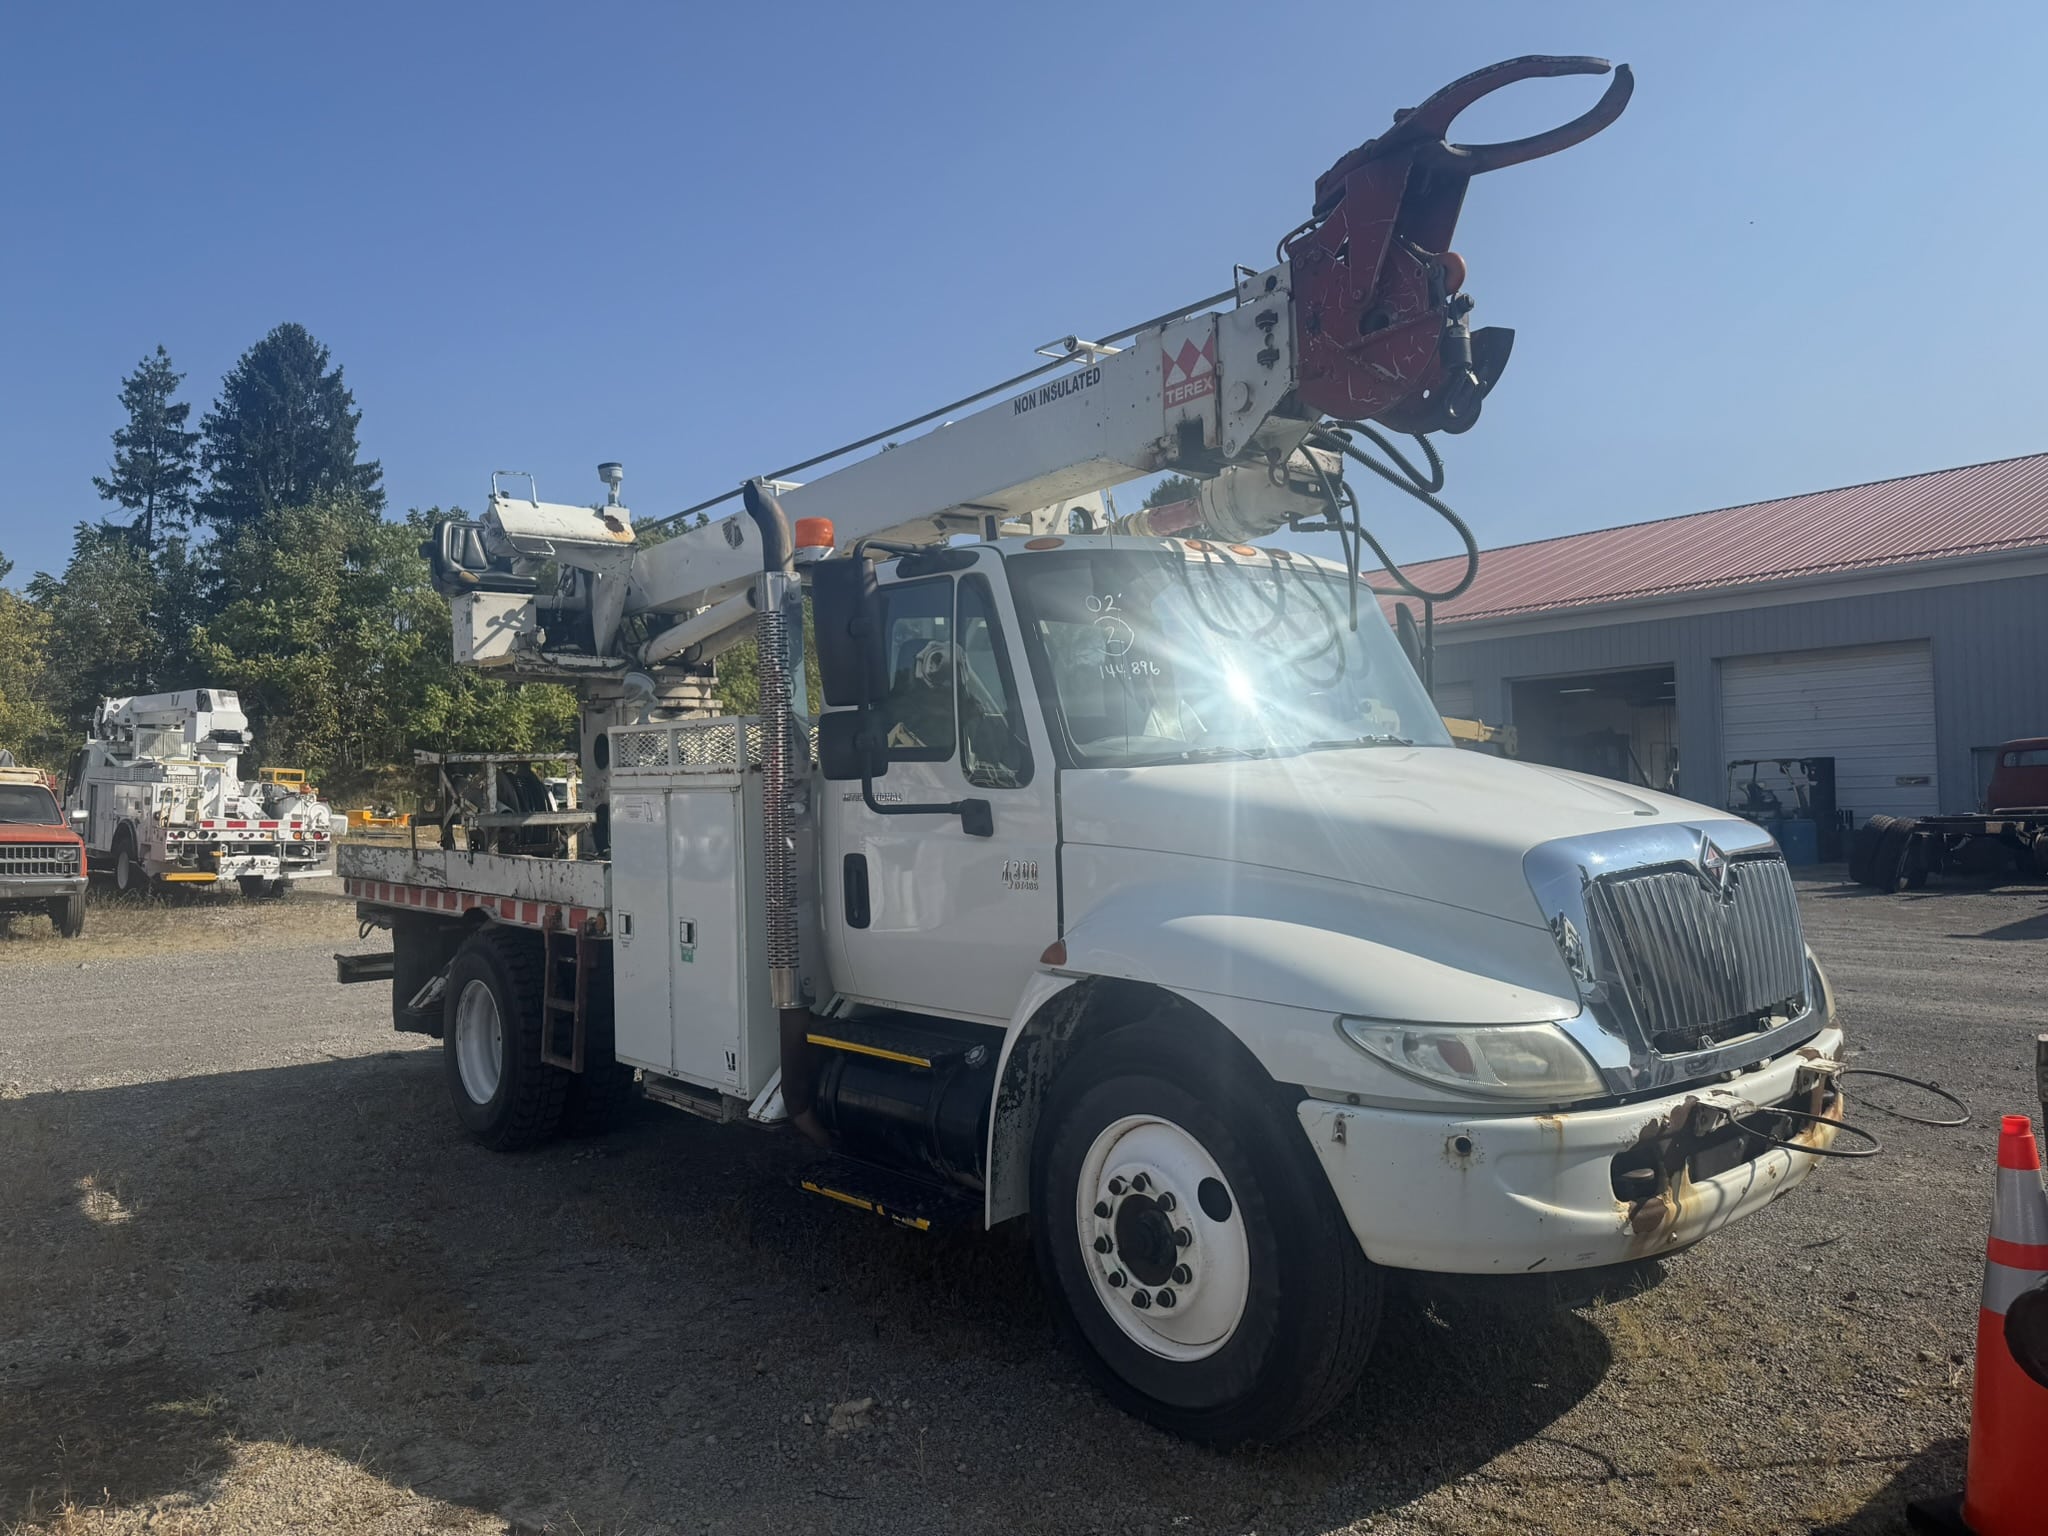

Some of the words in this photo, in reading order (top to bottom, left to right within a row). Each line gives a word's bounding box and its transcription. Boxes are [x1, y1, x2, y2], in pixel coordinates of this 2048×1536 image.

[1014, 392, 1036, 415] NON
[1040, 367, 1100, 405] INSULATED
[1166, 376, 1213, 403] TEREX
